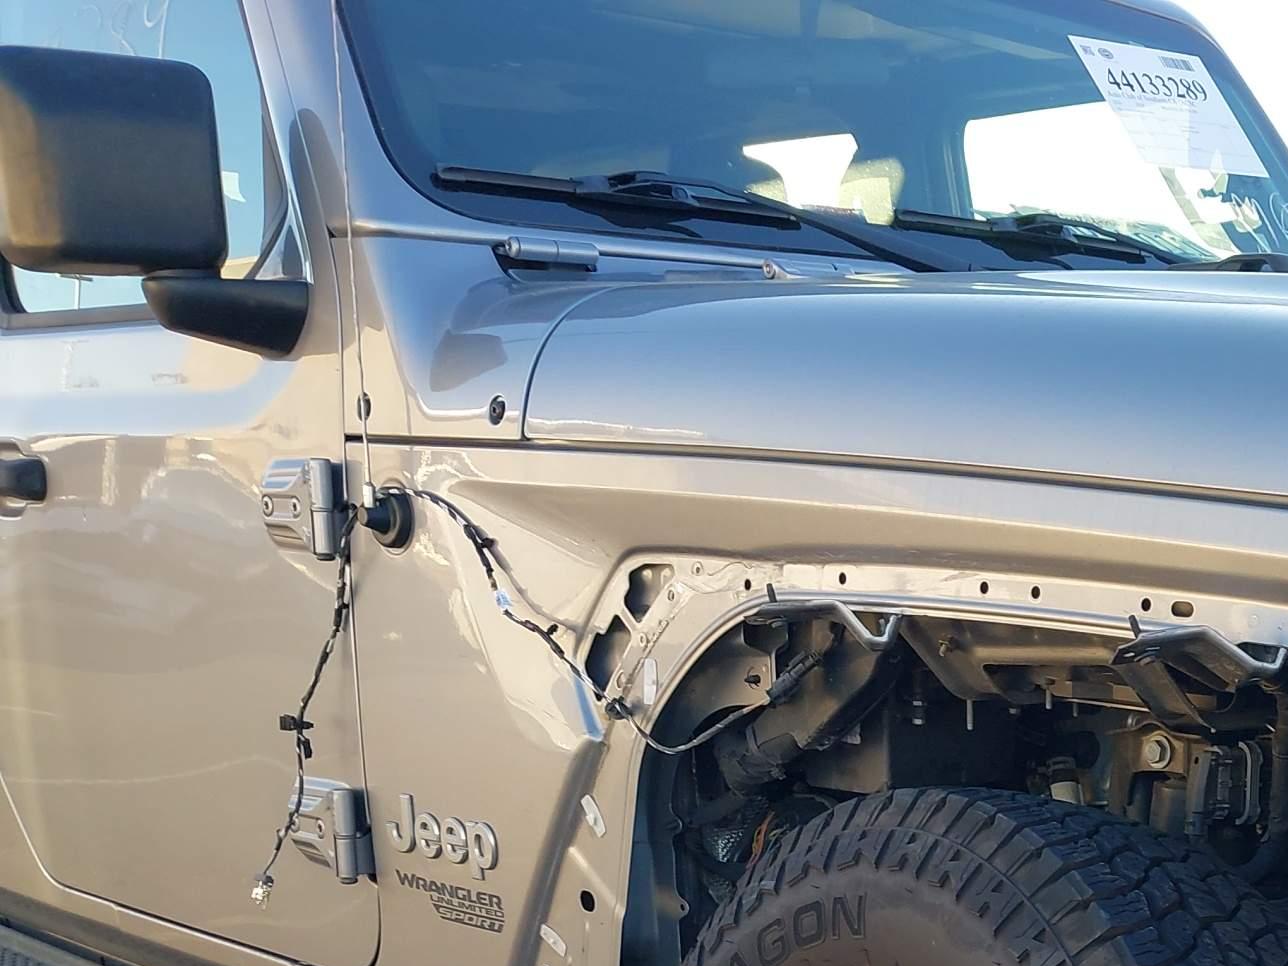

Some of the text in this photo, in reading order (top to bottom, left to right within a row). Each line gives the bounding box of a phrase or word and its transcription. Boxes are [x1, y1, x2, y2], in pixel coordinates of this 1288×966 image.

[1107, 67, 1208, 102] 44133289
[385, 792, 499, 881] Jeep
[395, 868, 504, 910] WRANGLER
[430, 894, 505, 919] UNLIMITED
[438, 906, 504, 932] SPORT
